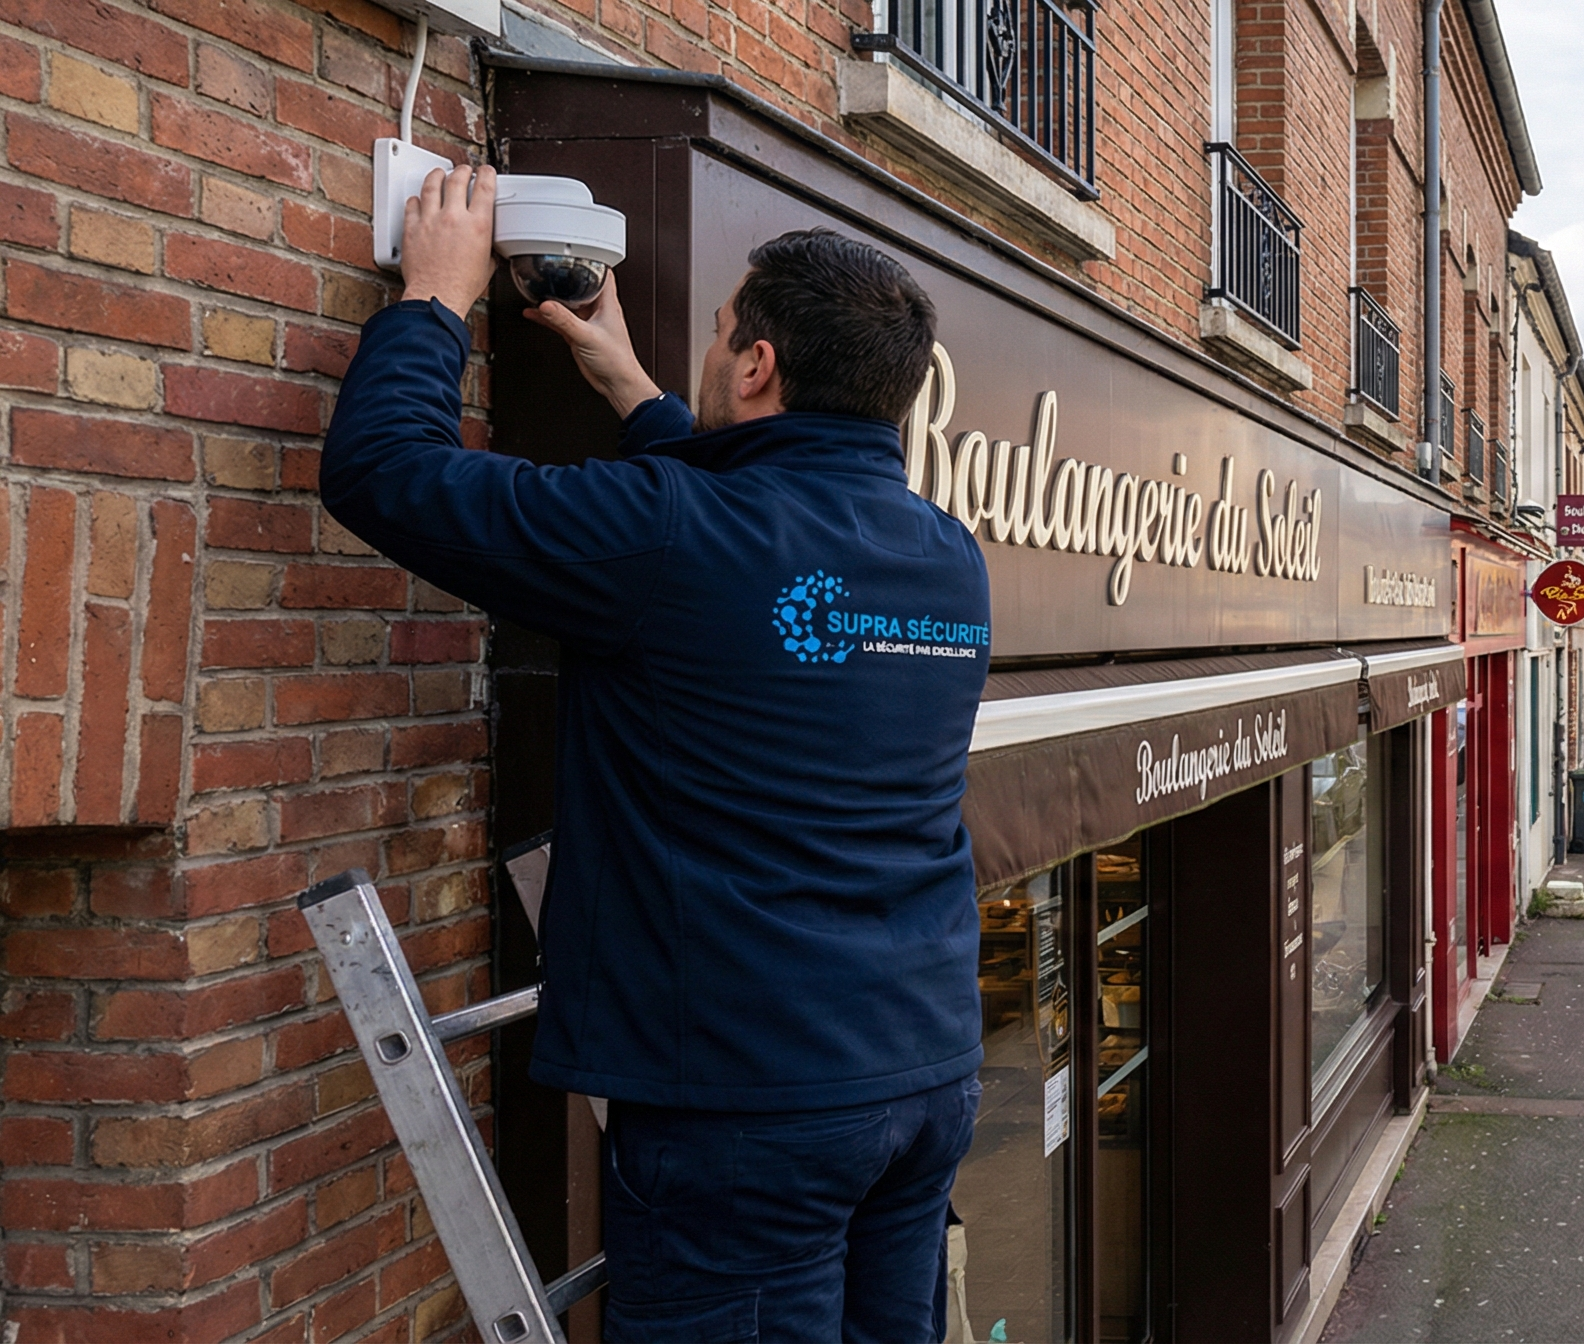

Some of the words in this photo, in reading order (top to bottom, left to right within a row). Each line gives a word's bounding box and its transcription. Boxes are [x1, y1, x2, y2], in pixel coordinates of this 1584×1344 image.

[907, 341, 1203, 606] Boulangerie
[1209, 455, 1251, 574] du
[1256, 468, 1322, 581] Soleil
[827, 611, 902, 639] SUPRA
[907, 615, 989, 645] SÉCURITÉ
[1136, 728, 1232, 804] Boulangerie
[1234, 718, 1252, 771] du
[1254, 708, 1288, 765] Soleil
